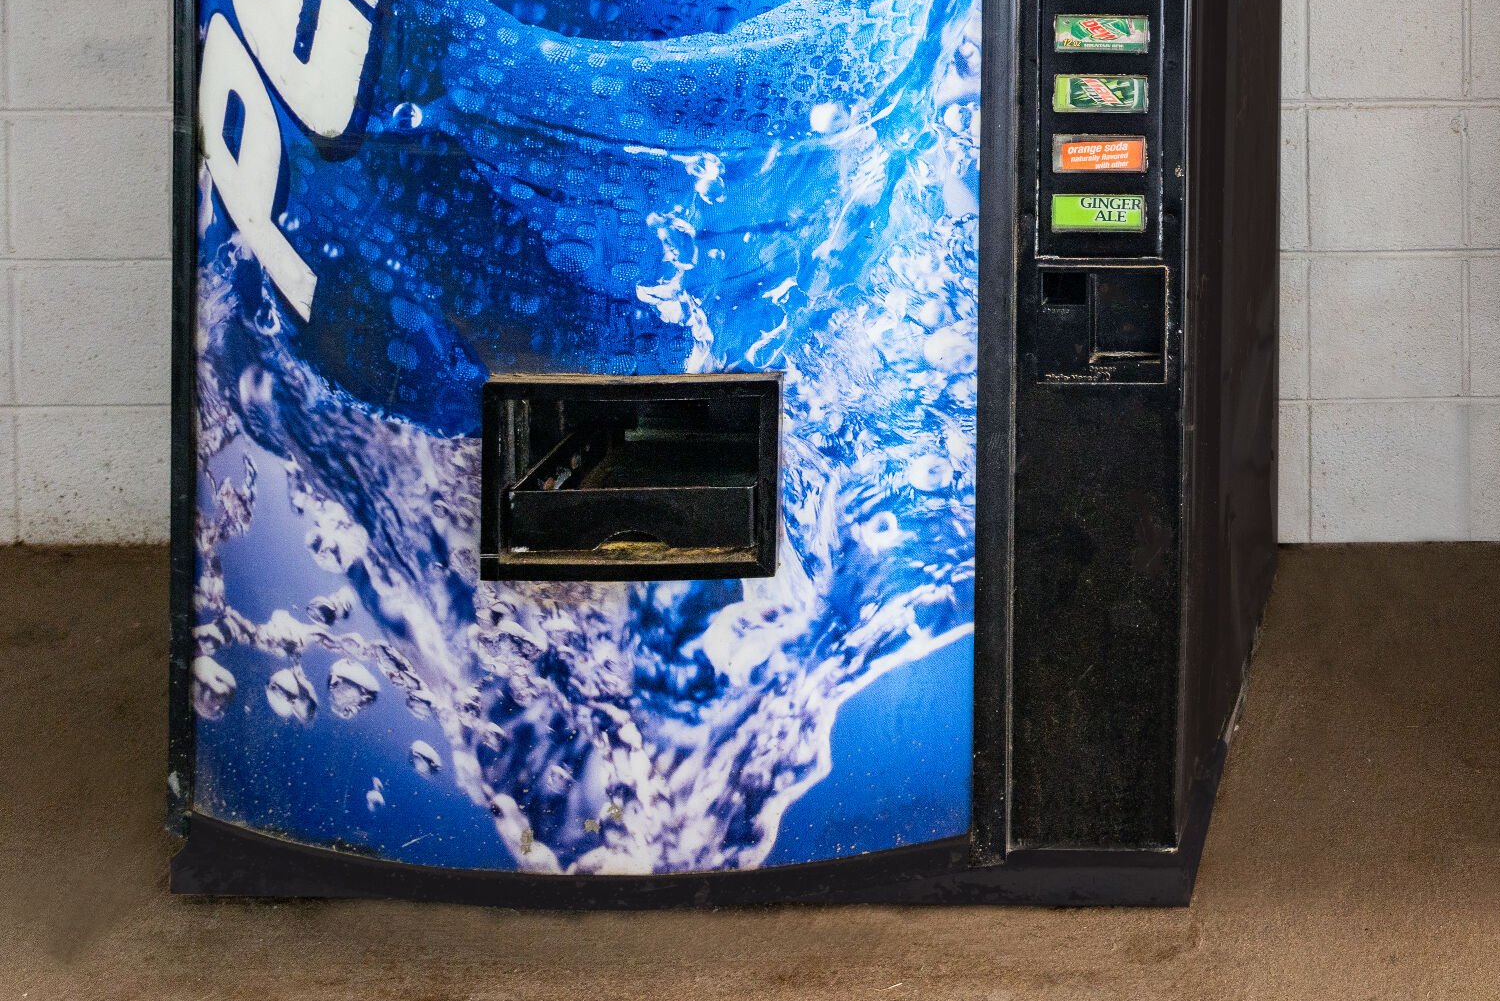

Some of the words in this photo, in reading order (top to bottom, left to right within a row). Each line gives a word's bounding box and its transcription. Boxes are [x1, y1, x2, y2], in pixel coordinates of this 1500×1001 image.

[1068, 145, 1102, 154] orange
[1104, 142, 1128, 151] soda
[1080, 198, 1141, 210] GINGER
[1095, 210, 1126, 222] ALE
